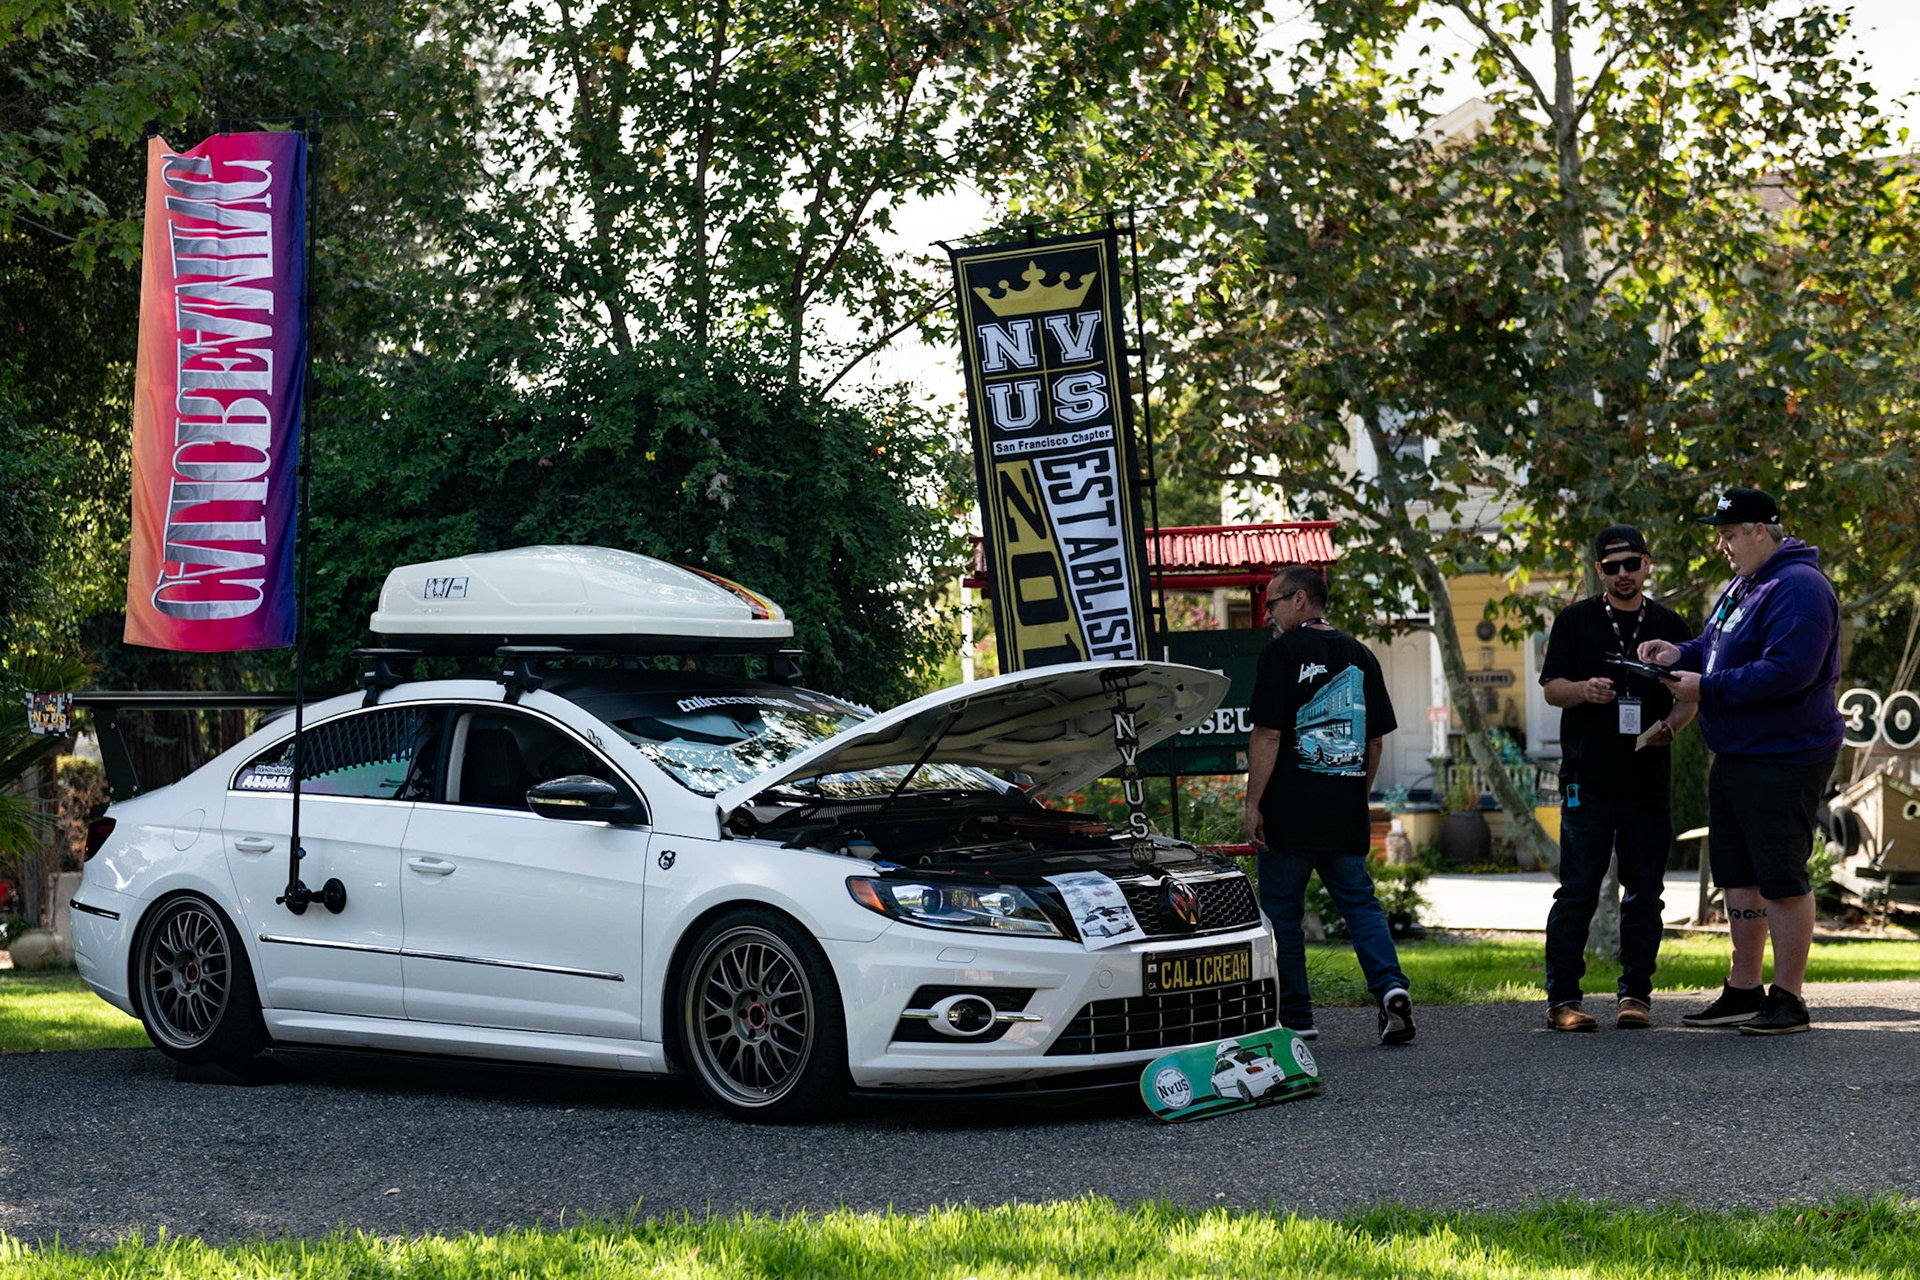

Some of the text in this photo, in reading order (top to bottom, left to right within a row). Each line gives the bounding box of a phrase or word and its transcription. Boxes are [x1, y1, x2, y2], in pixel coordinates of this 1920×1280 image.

[996, 429, 1110, 453] San Francisco Chapter
[1467, 674, 1509, 684] WELCOME
[1179, 707, 1255, 735] SEU
[1161, 953, 1249, 989] CALICREAM
[1148, 982, 1157, 990] CA
[1157, 1079, 1190, 1099] NvUS
